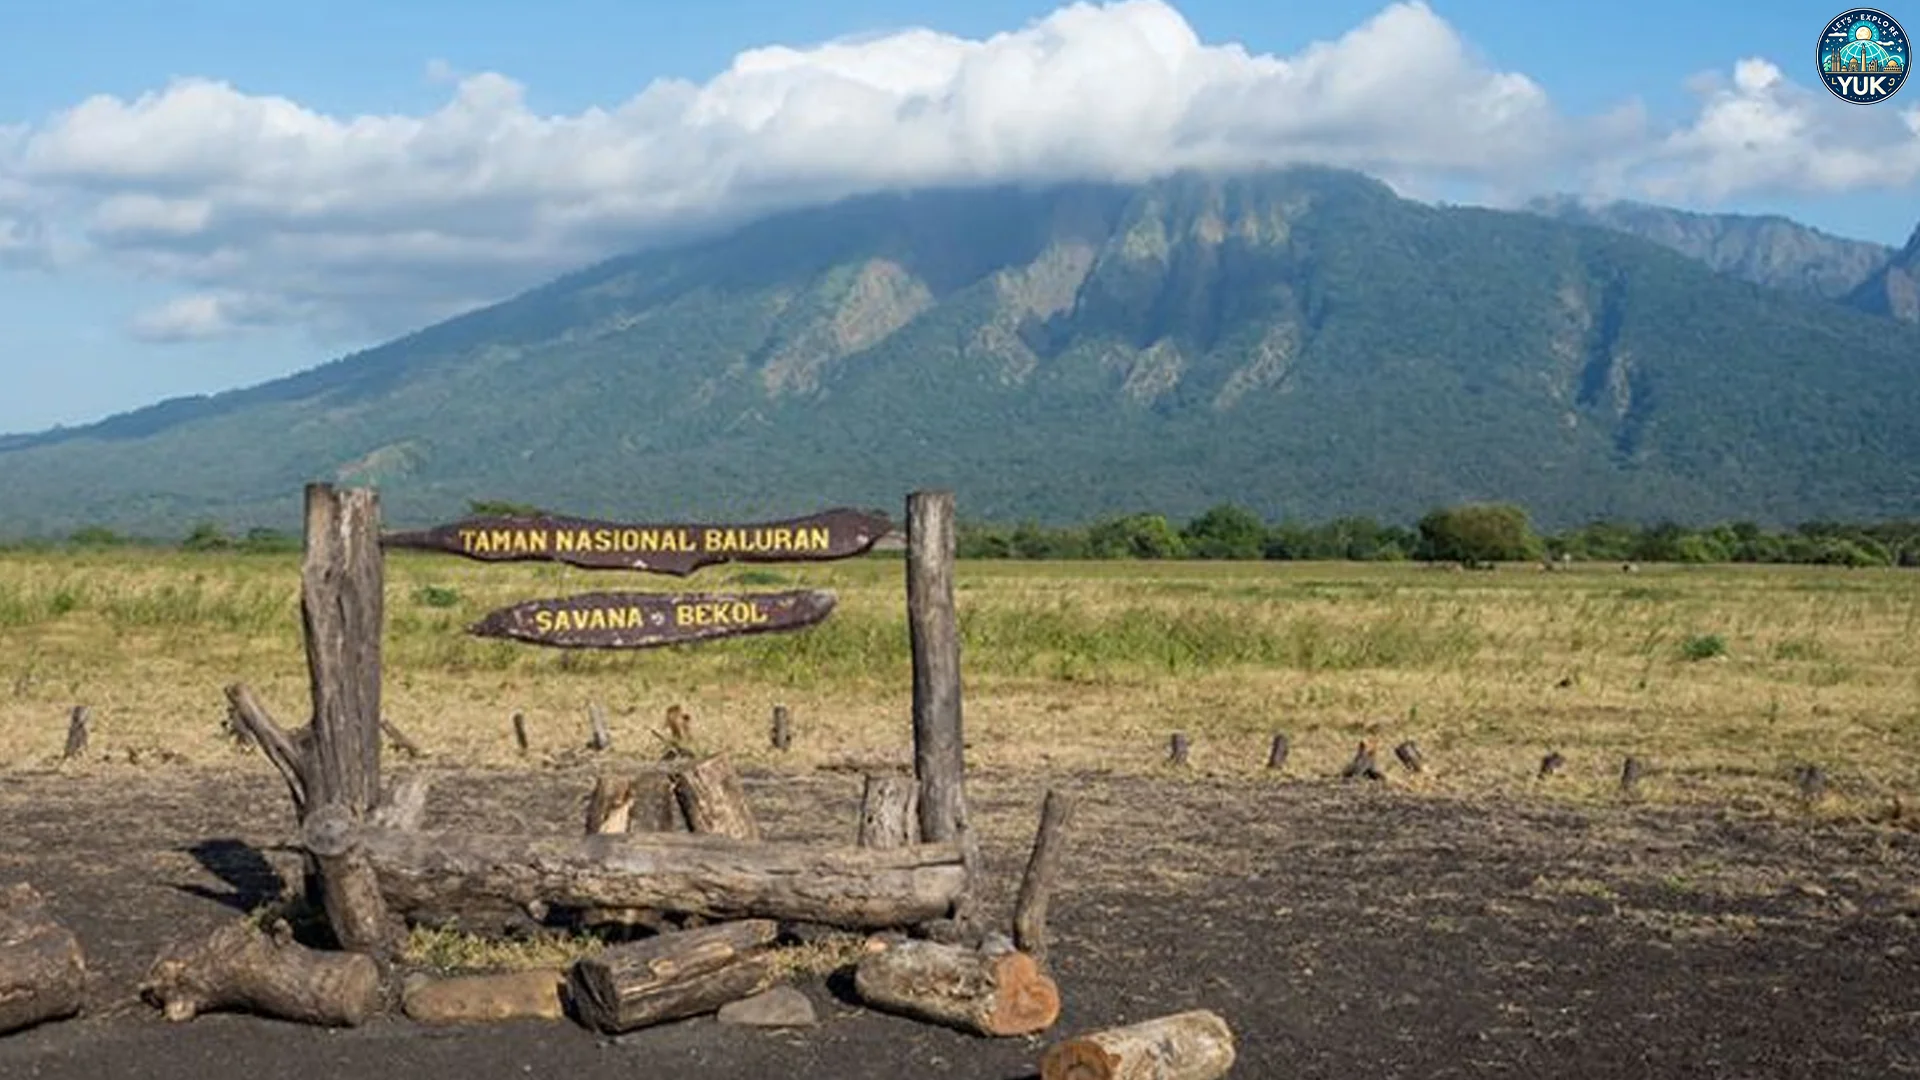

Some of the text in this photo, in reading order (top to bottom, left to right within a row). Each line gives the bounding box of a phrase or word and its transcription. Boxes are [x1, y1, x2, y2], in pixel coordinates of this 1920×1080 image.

[458, 527, 830, 552] TAMAN NASIONAL BALURAN
[535, 601, 768, 634] SAVANA BEKOL
